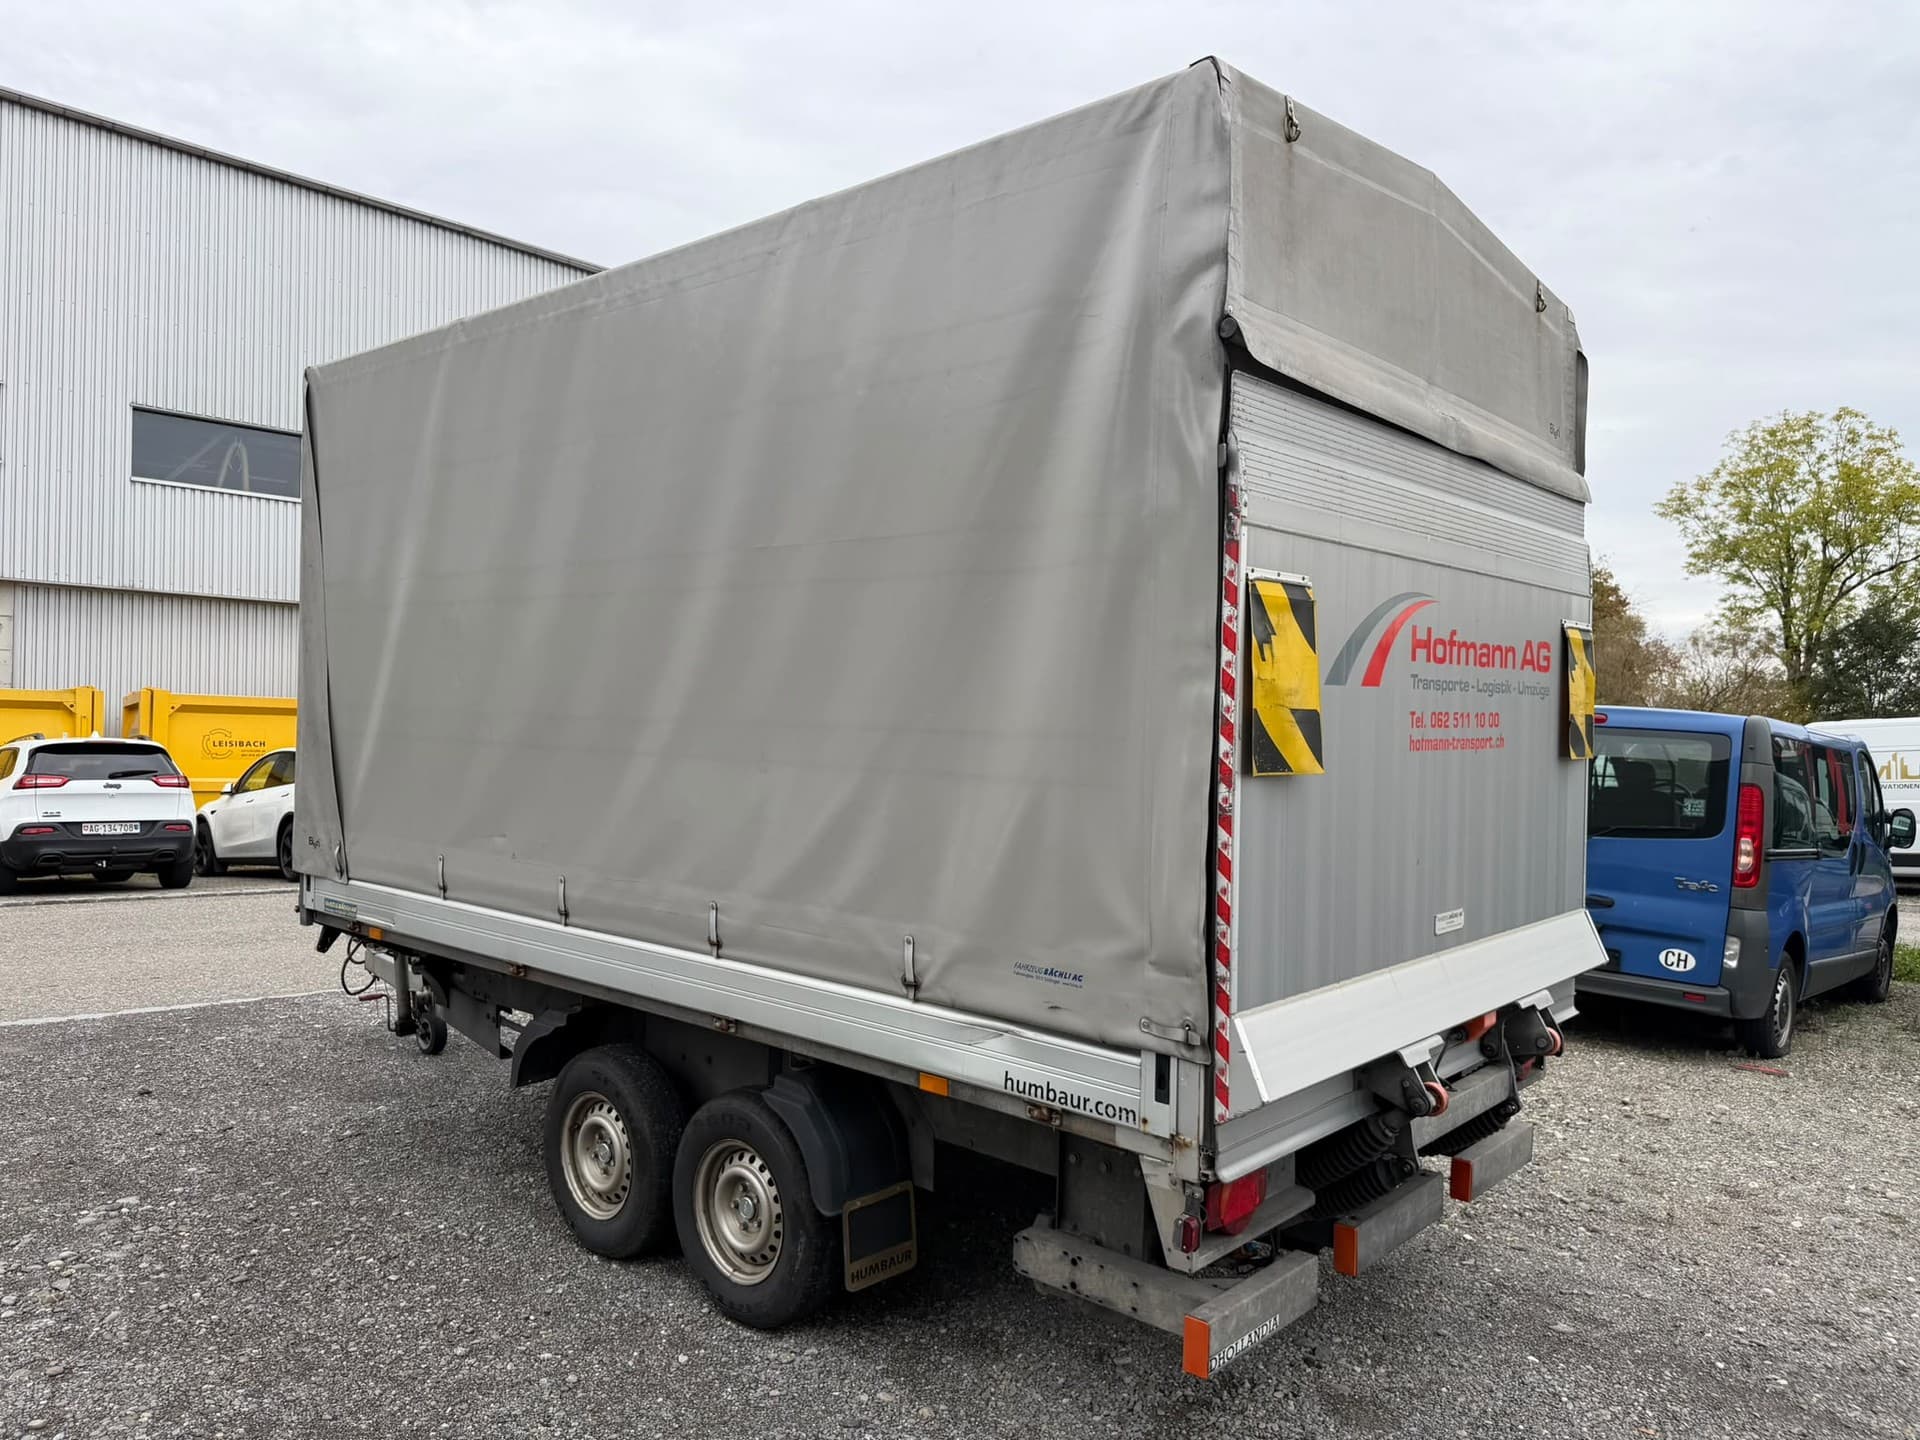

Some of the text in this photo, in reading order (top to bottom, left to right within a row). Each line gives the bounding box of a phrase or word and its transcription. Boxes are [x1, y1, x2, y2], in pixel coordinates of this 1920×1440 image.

[1410, 625, 1552, 674] Hofmann AG
[1410, 673, 1470, 695] Transporte
[1410, 711, 1500, 728] Tel. 062 511 10 00
[212, 740, 266, 748] LEISIBACH
[1664, 950, 1688, 969] CH
[1003, 1071, 1137, 1125] humbaur.com
[851, 1249, 912, 1284] HUMBAUR
[1208, 1313, 1280, 1373] DHOLLANDIA
